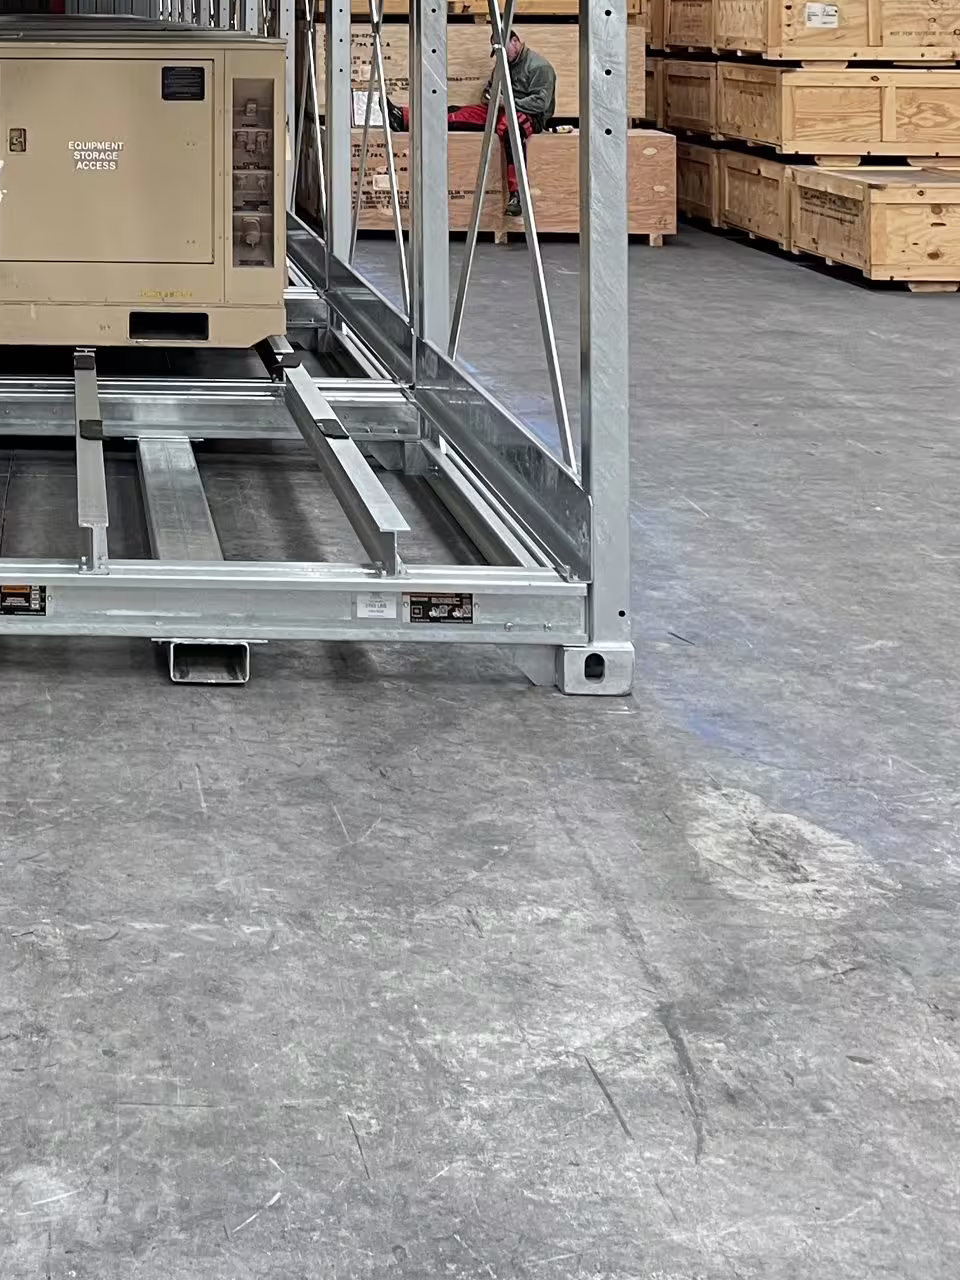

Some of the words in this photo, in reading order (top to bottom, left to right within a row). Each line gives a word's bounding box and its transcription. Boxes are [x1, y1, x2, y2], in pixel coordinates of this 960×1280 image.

[68, 141, 125, 150] EQUIPMENT
[73, 151, 119, 160] STORAGE
[76, 161, 117, 170] ACCESS
